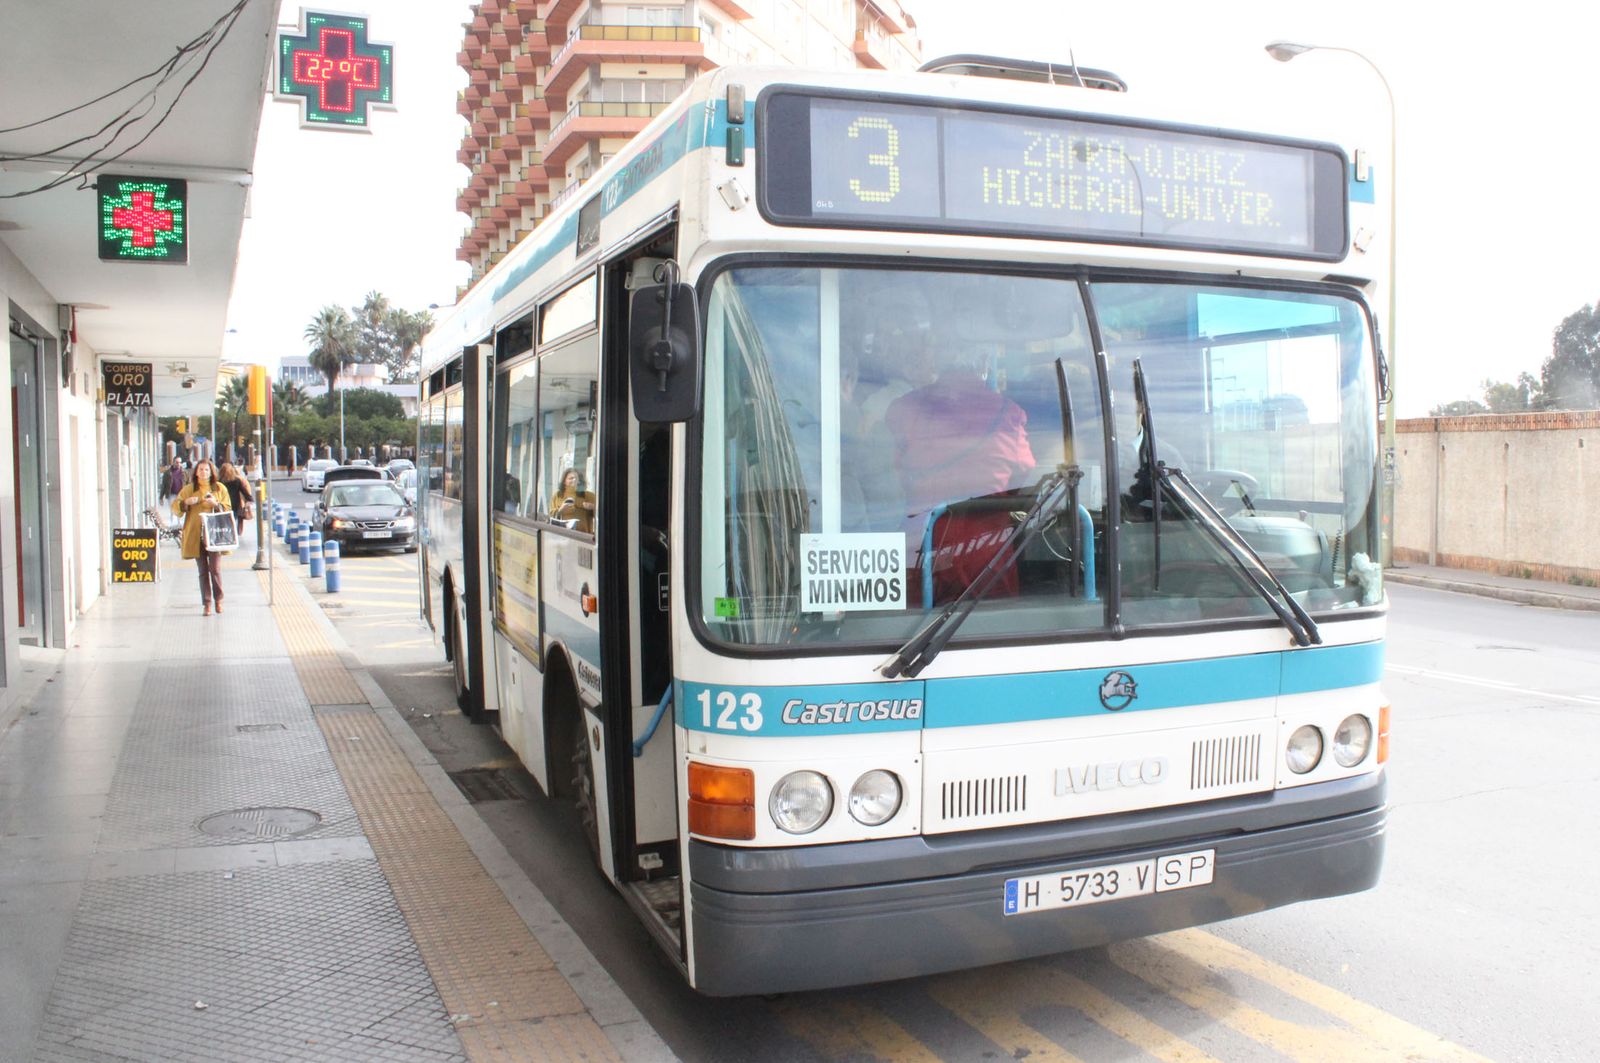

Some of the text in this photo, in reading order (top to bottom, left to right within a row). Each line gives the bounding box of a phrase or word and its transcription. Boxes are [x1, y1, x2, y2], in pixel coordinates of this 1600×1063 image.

[847, 116, 900, 203] 3
[104, 364, 150, 374] COMPRO
[112, 373, 145, 386] ORO
[106, 392, 151, 406] PLATA
[113, 538, 156, 548] COMPRO
[121, 550, 148, 561] ORO
[807, 548, 900, 575] SERVICIOS
[113, 571, 153, 582] PLATA
[808, 577, 901, 605] MINIMOS
[697, 689, 764, 731] 123
[782, 695, 922, 725] Castrosua
[1053, 756, 1170, 797] IVECO
[1024, 880, 1040, 908] H
[1060, 870, 1120, 902] 5733
[1136, 865, 1149, 890] V
